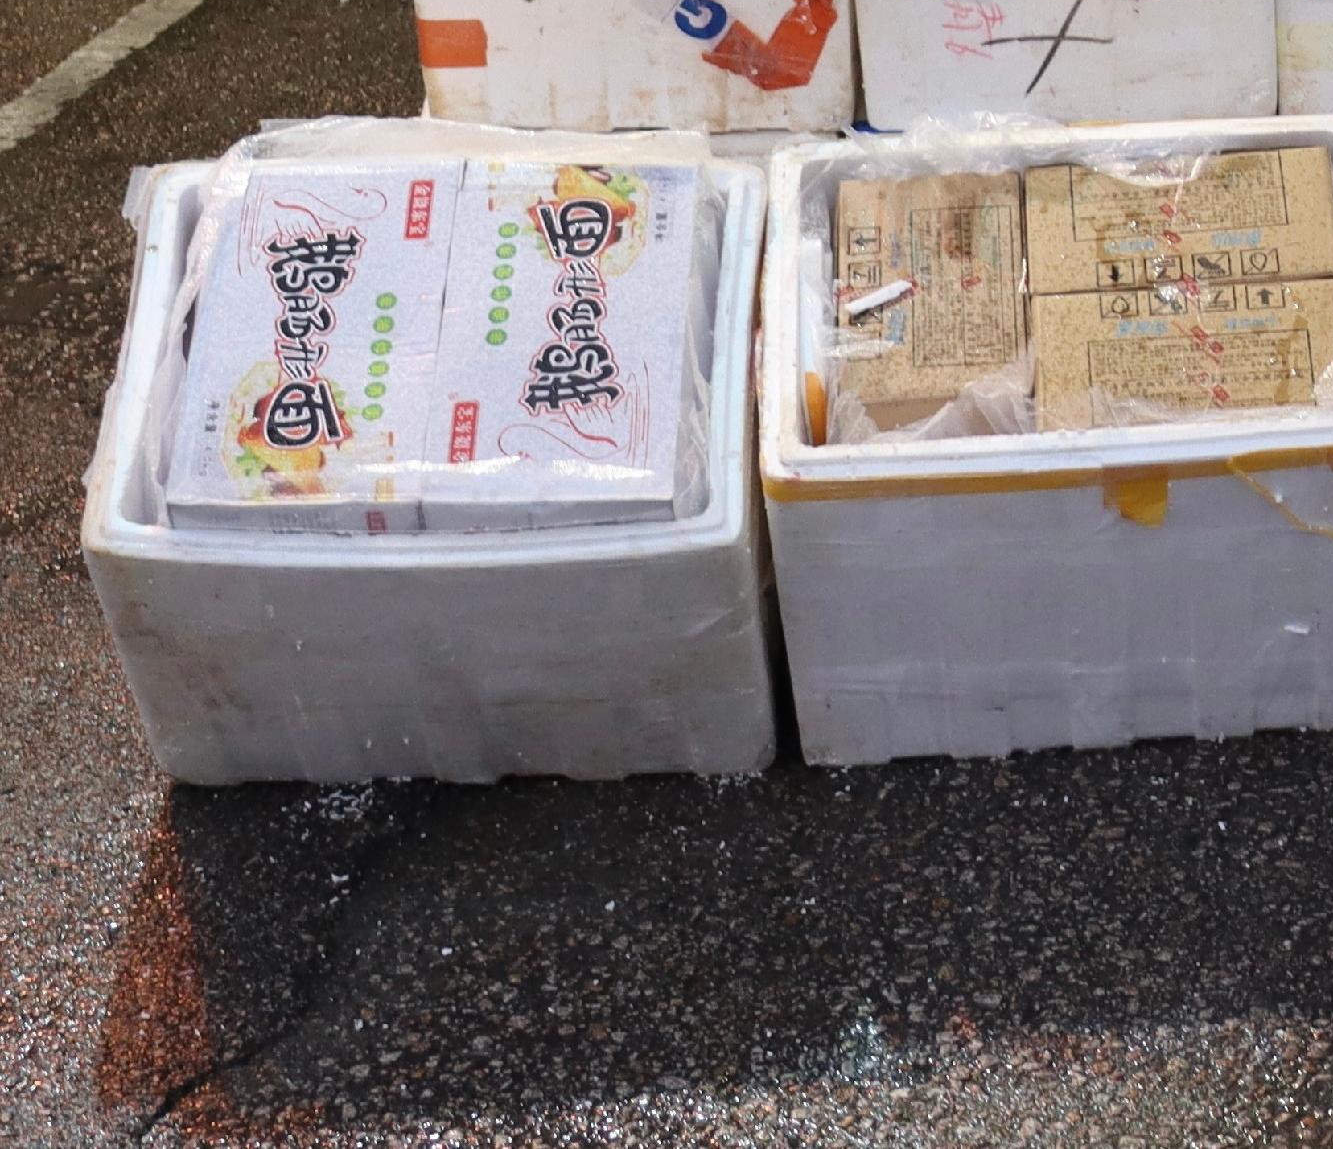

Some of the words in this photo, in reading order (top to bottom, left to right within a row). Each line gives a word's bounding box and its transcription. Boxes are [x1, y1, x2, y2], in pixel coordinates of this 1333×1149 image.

[265, 229, 367, 448] 鹅肠形面
[525, 199, 625, 412] 鹅肠形面
